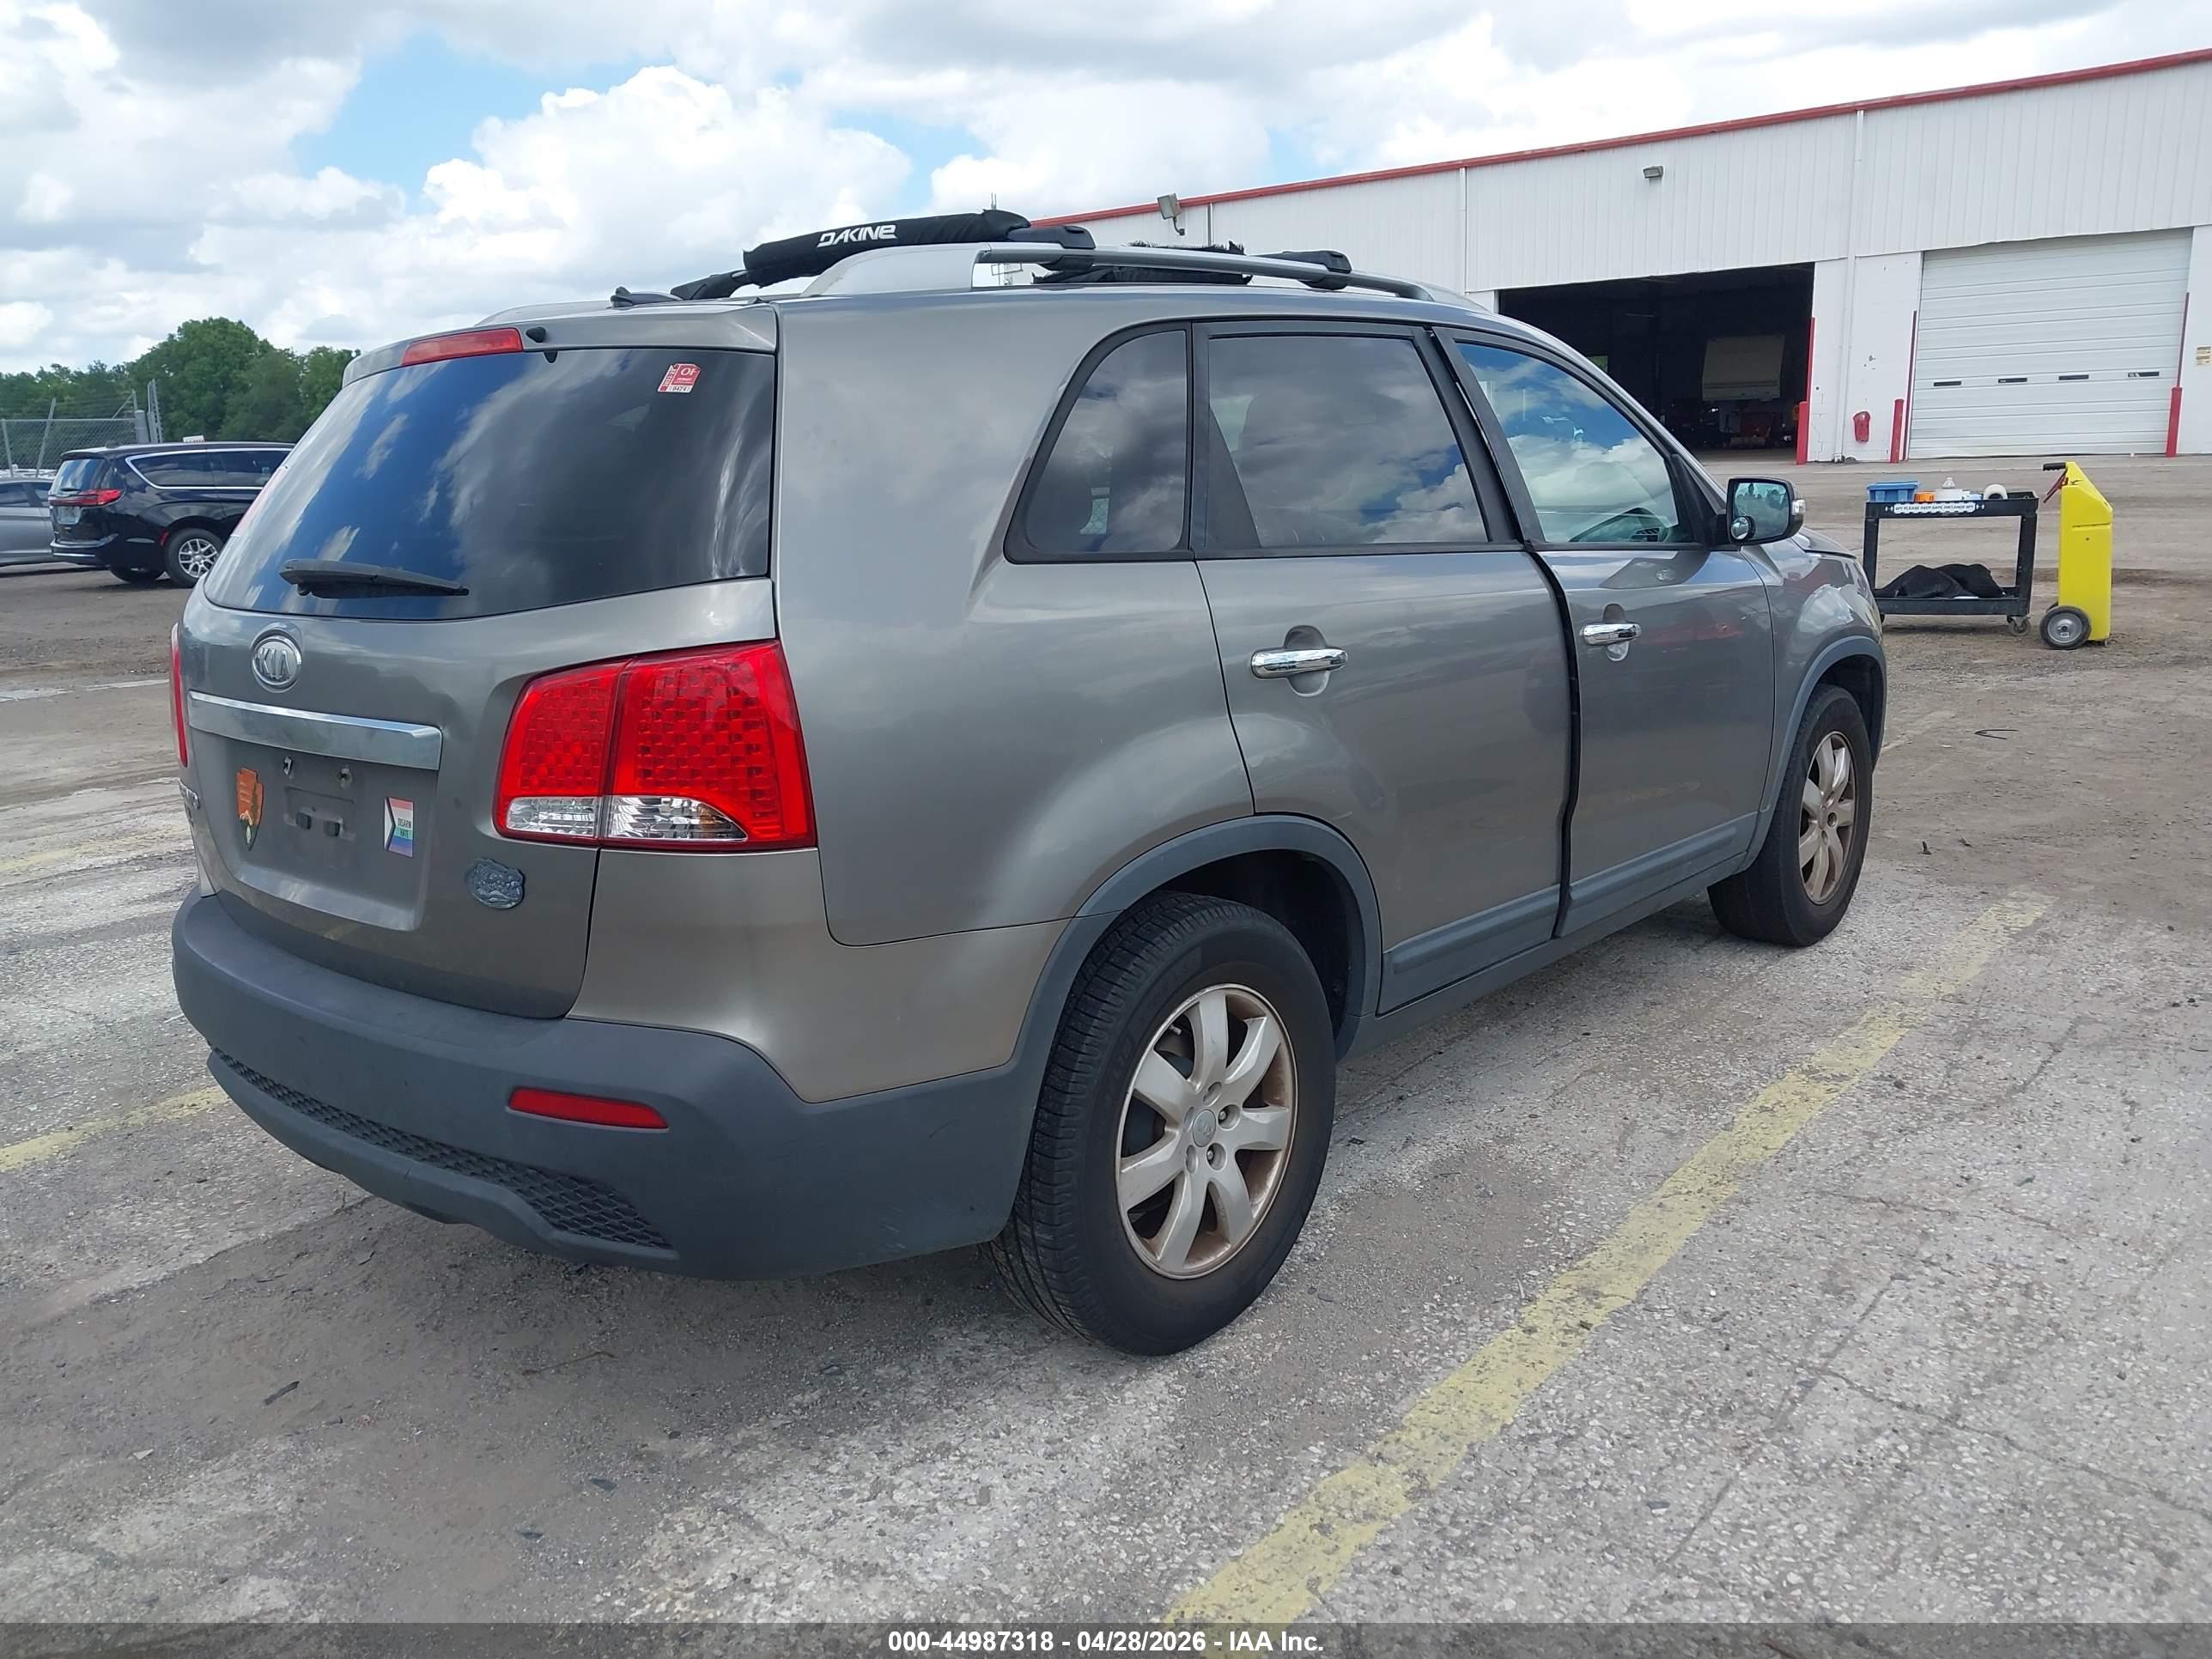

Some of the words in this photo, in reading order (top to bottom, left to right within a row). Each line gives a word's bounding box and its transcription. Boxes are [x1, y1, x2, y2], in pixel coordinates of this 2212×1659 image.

[817, 224, 897, 247] DAKINE
[680, 368, 699, 376] OF
[258, 647, 295, 679] KIA
